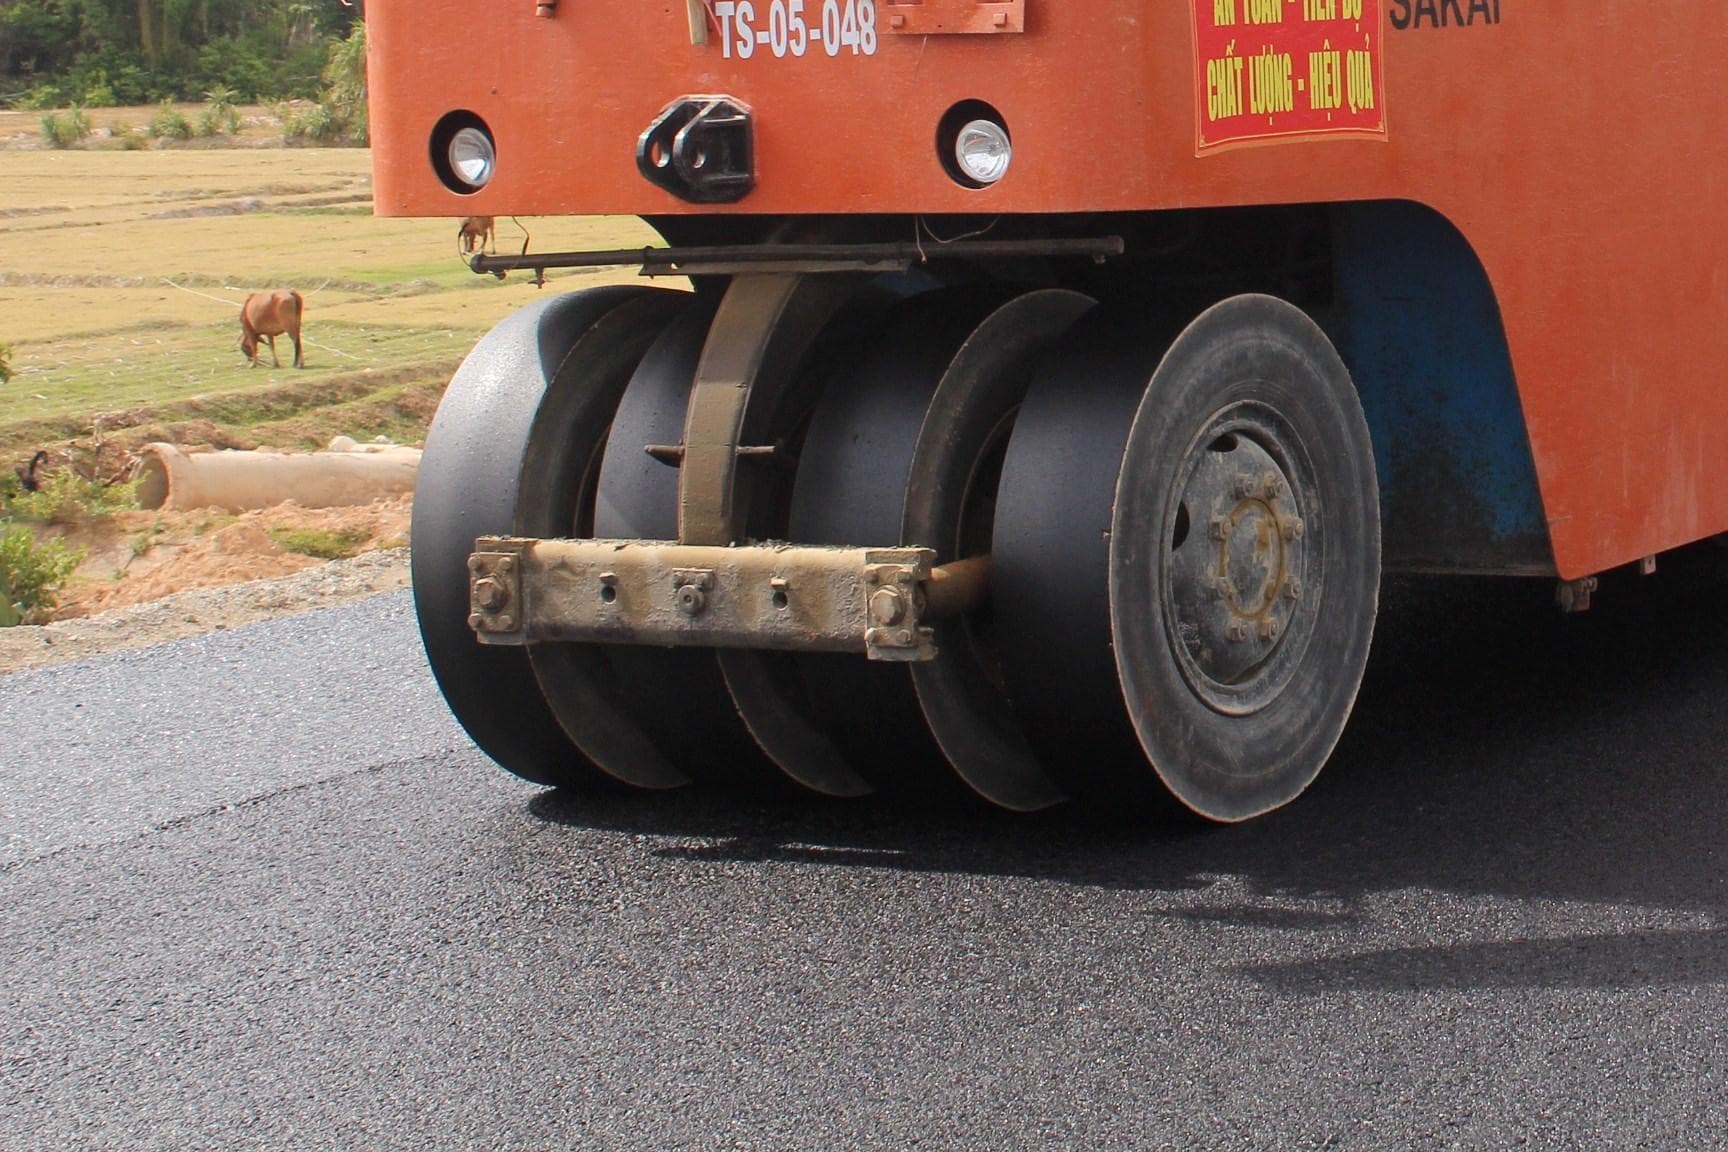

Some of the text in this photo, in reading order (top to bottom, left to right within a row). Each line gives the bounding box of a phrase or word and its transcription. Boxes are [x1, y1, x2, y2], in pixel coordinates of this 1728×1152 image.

[1207, 39, 1243, 122] CHẤT
[1249, 44, 1294, 126] LƯỢNG
[1309, 38, 1342, 122] HIỆU
[1346, 33, 1375, 115] QUẢ
